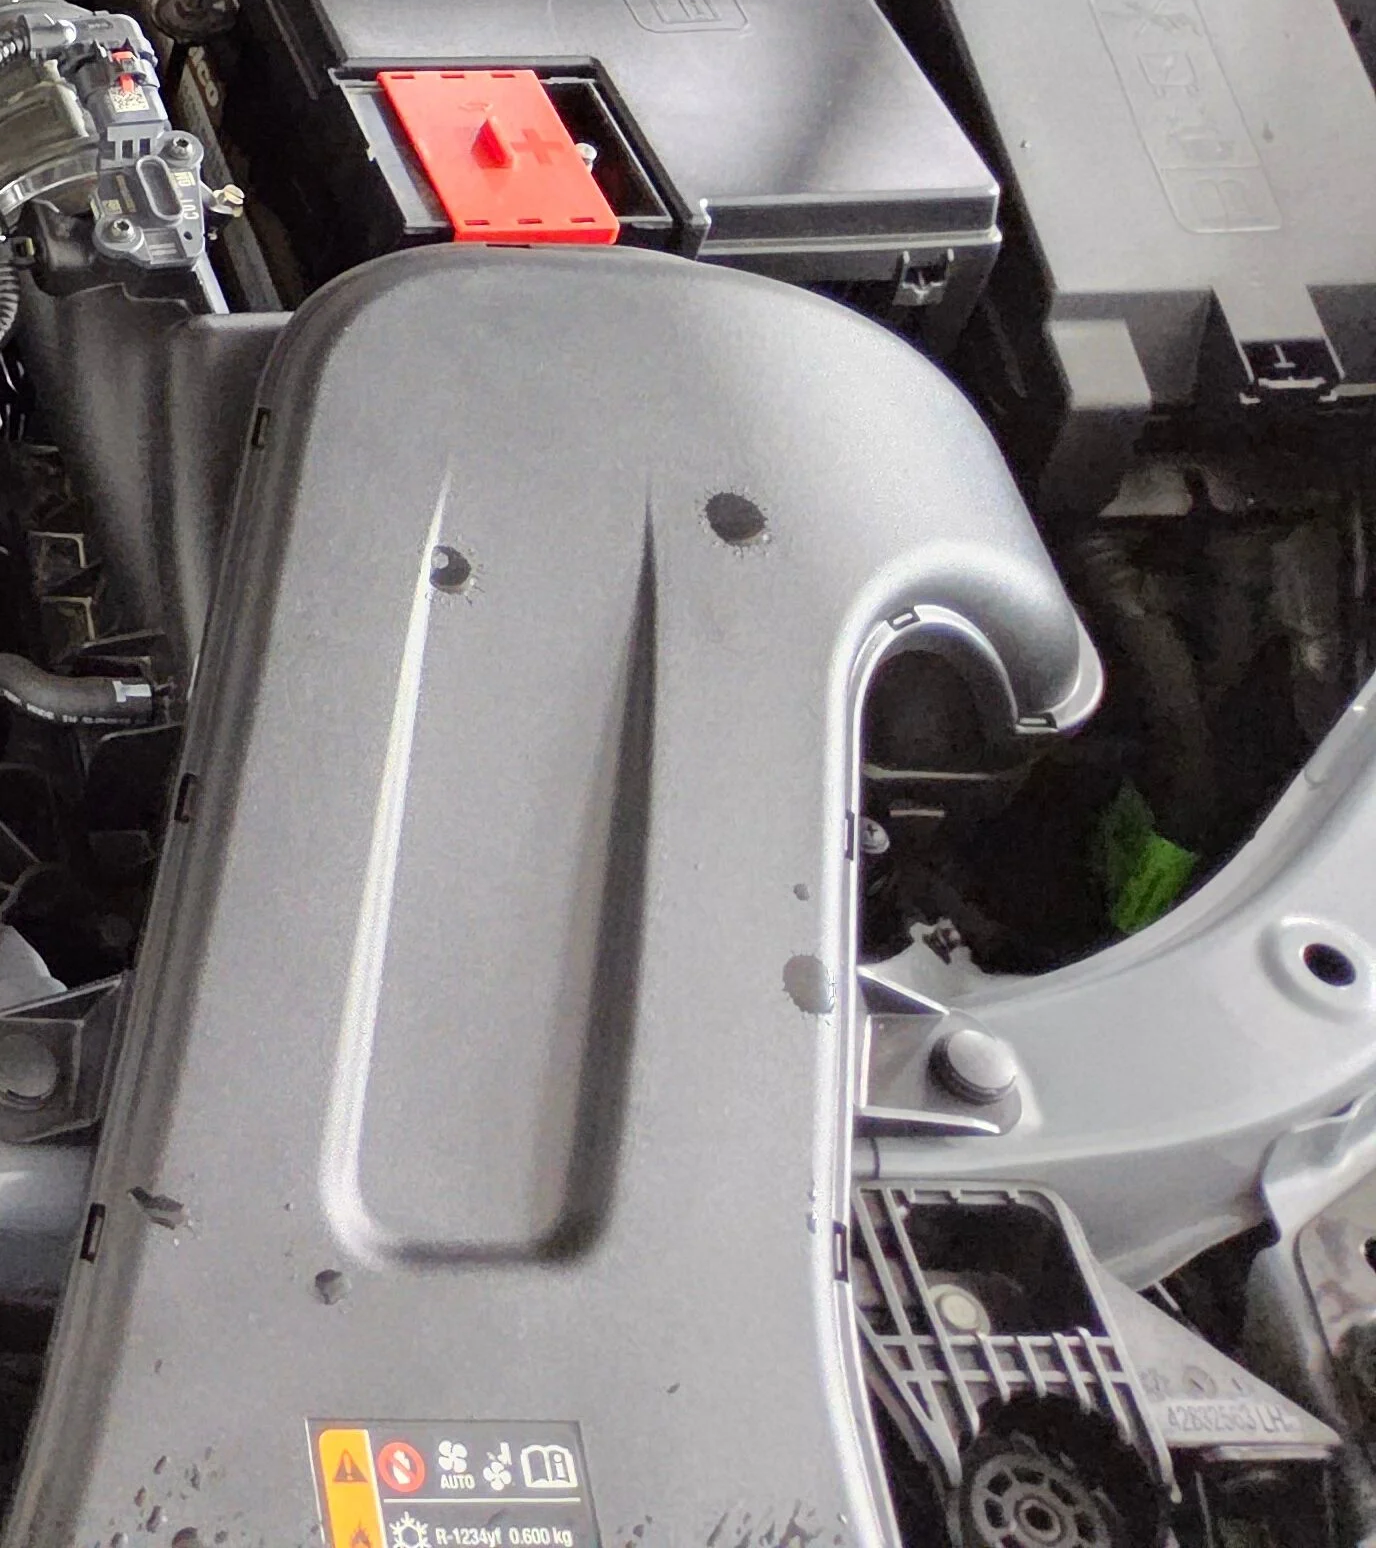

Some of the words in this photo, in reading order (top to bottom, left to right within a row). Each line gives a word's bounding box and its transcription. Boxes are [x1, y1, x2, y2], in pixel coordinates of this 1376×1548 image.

[440, 1473, 475, 1490] AUTO
[435, 1526, 502, 1548] R-1234yf
[509, 1527, 550, 1545] 0.600
[552, 1526, 573, 1547] kg
